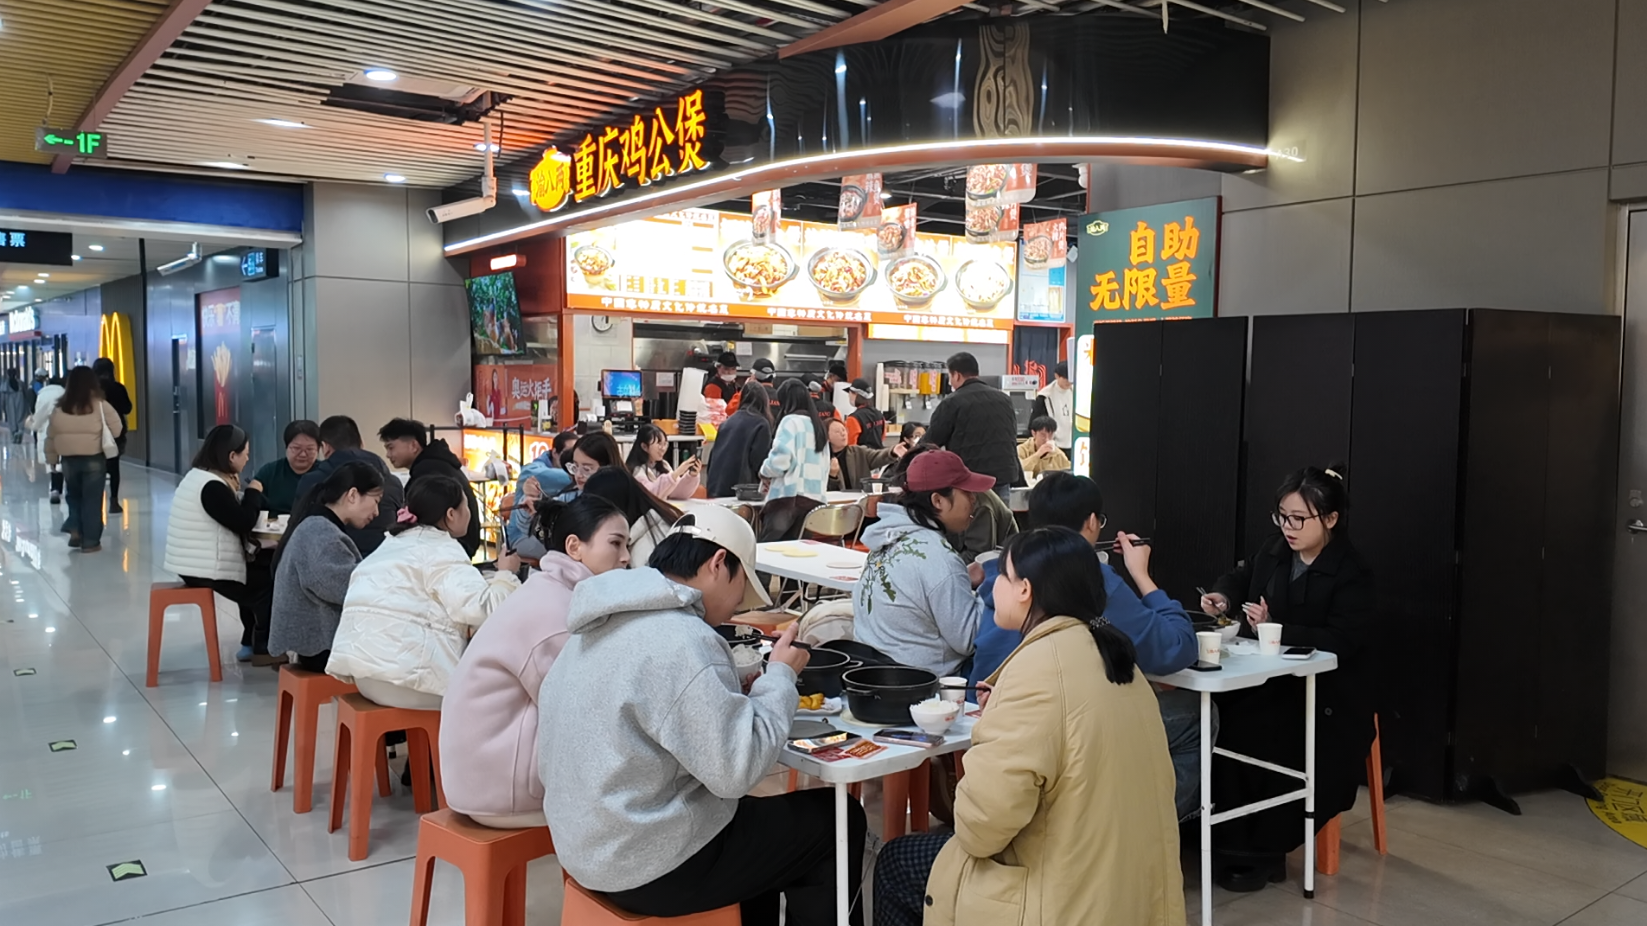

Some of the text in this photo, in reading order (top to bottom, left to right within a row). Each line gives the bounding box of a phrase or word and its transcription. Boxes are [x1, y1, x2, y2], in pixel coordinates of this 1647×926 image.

[573, 89, 709, 203] 重庆鸡公煲
[1129, 215, 1200, 264] 自助
[1088, 261, 1197, 311] 无限量
[511, 376, 552, 401] 奥运火炬手
